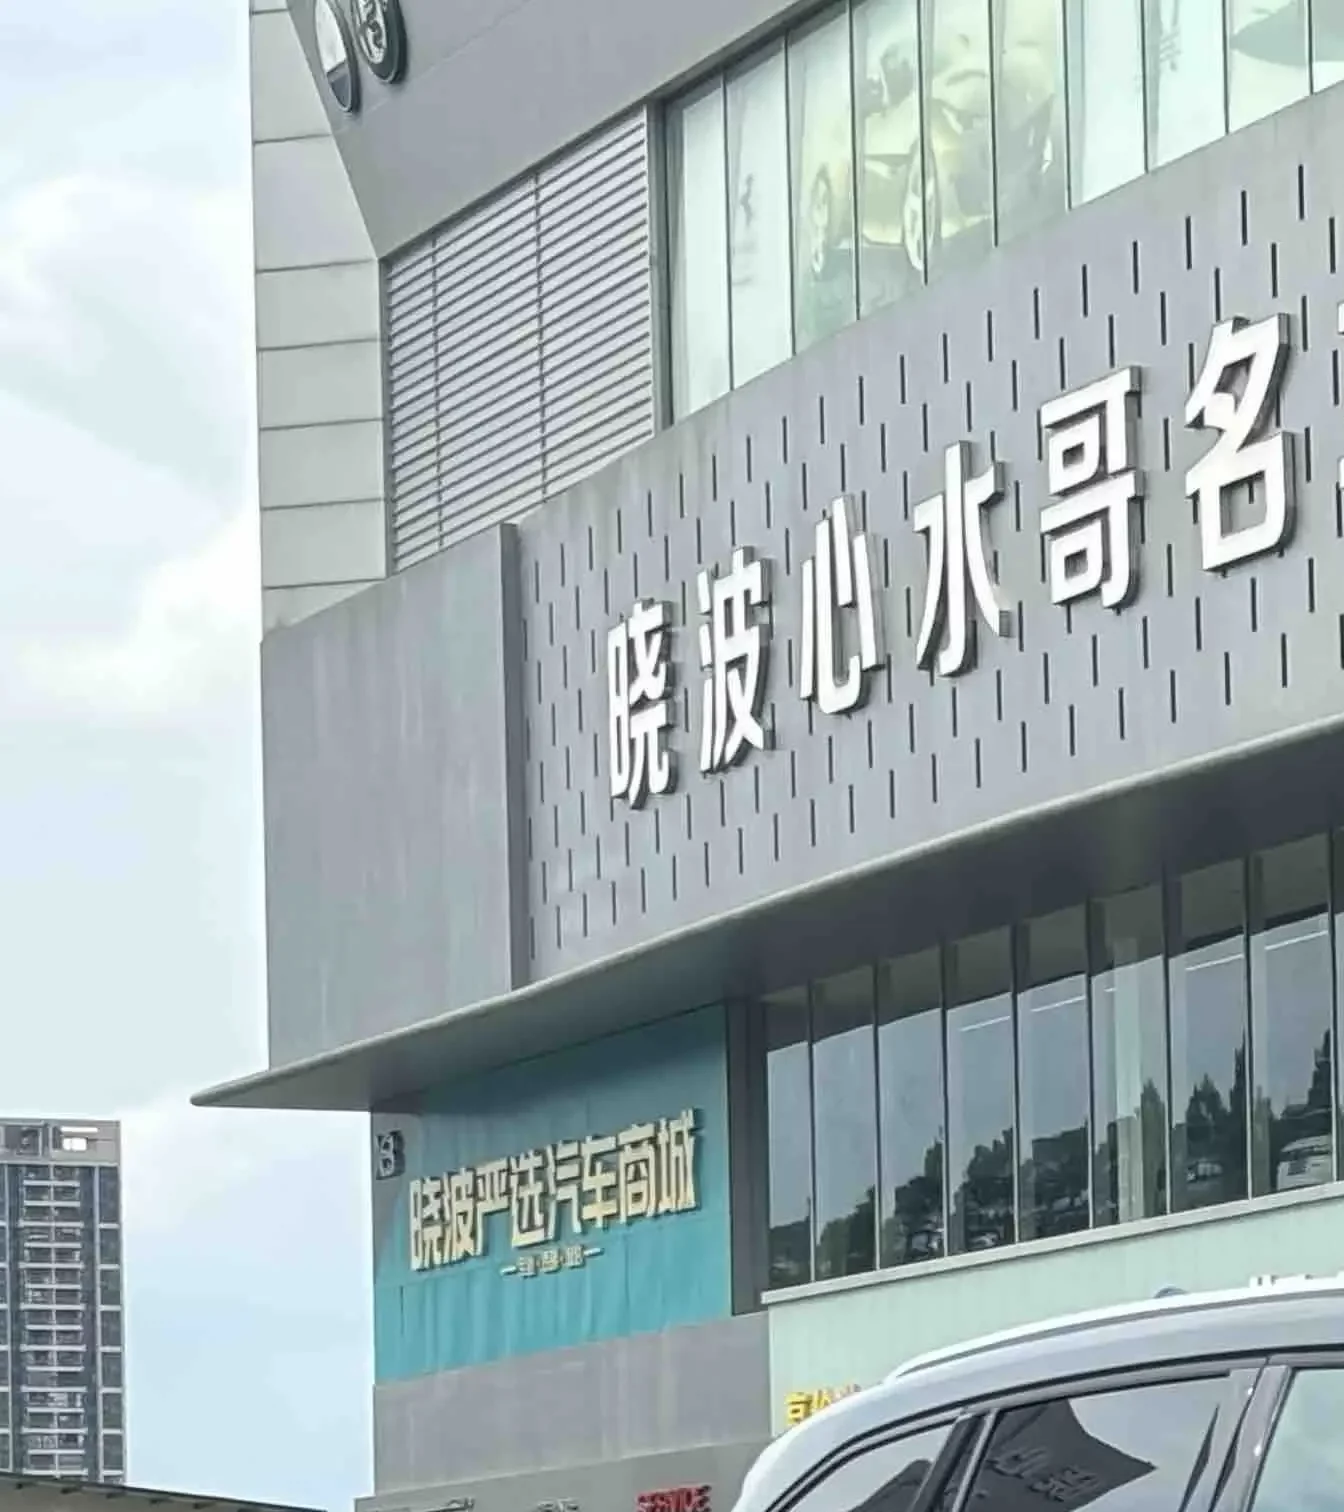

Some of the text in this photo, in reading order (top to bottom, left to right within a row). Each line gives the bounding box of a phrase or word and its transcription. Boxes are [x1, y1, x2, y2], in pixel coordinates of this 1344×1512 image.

[409, 1108, 698, 1271] 晓波严选汽车商城
